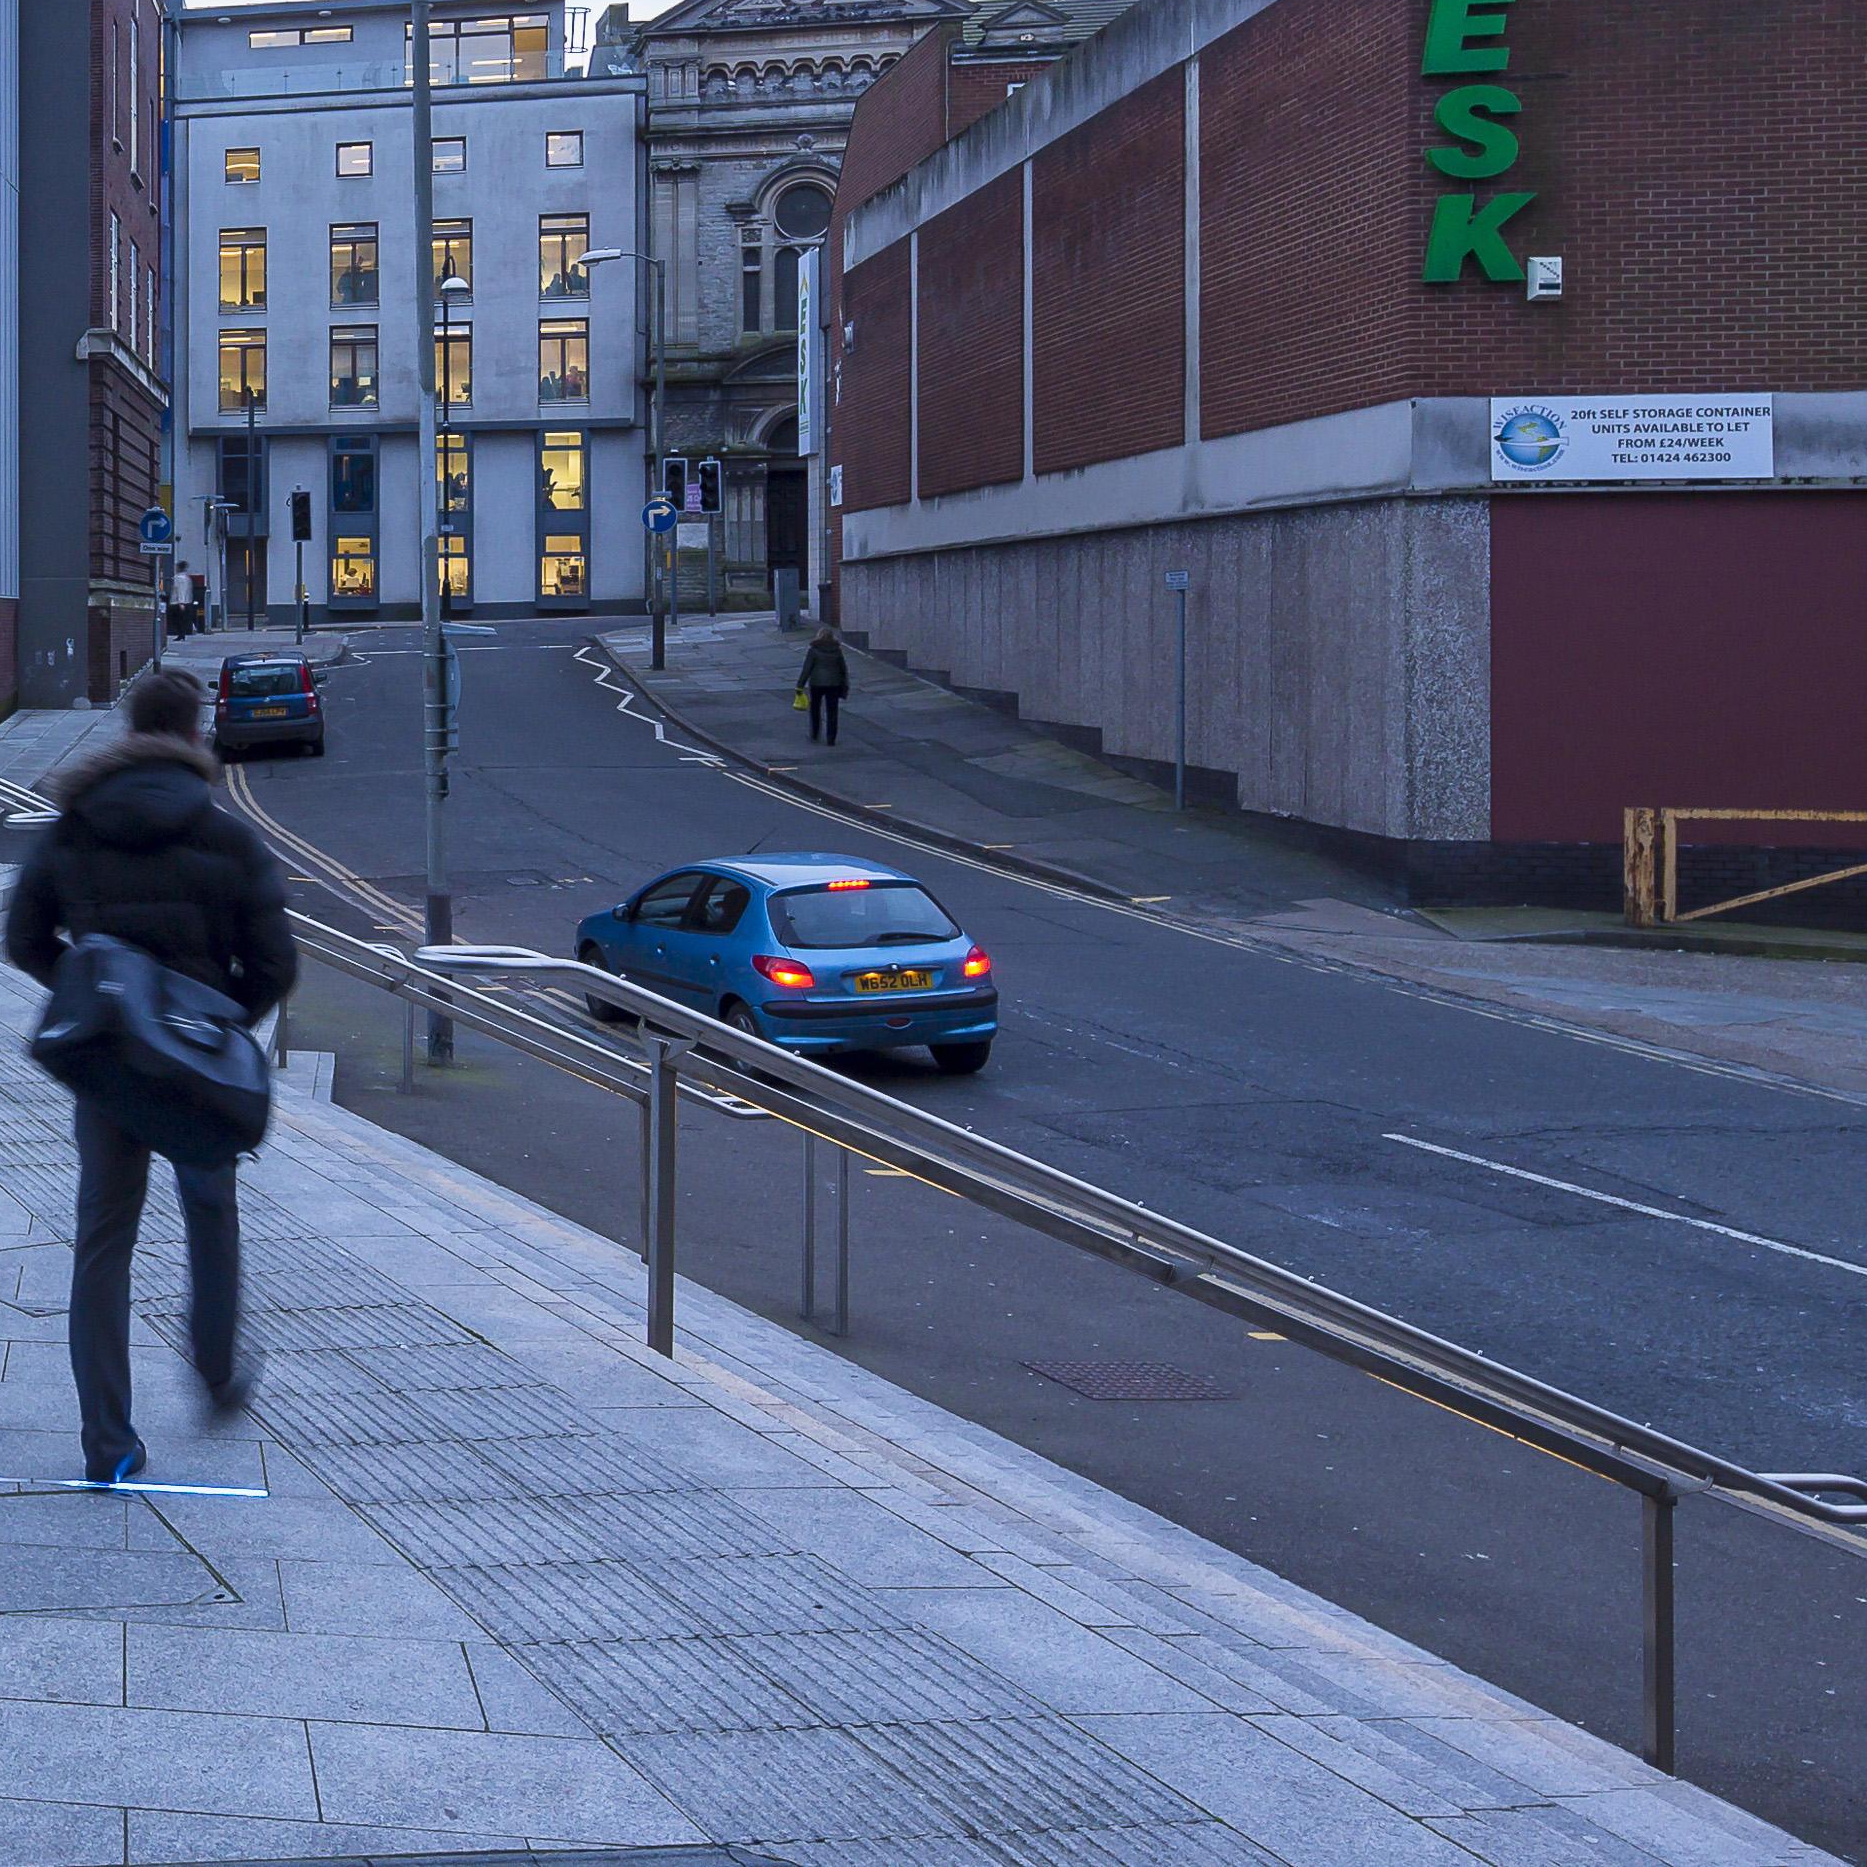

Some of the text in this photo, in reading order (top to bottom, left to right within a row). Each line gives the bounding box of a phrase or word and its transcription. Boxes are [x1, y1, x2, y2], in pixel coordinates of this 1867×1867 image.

[799, 297, 808, 416] ESK
[1493, 404, 1567, 430] WISEACTION
[1571, 406, 1771, 420] 20ft SELF STORAGE CONTAINER
[1592, 422, 1750, 434] UNITS AVAILABLE TO LET
[1618, 437, 1724, 449] FROM £24/WEEK
[1611, 452, 1731, 464] TEL: 01424 462300
